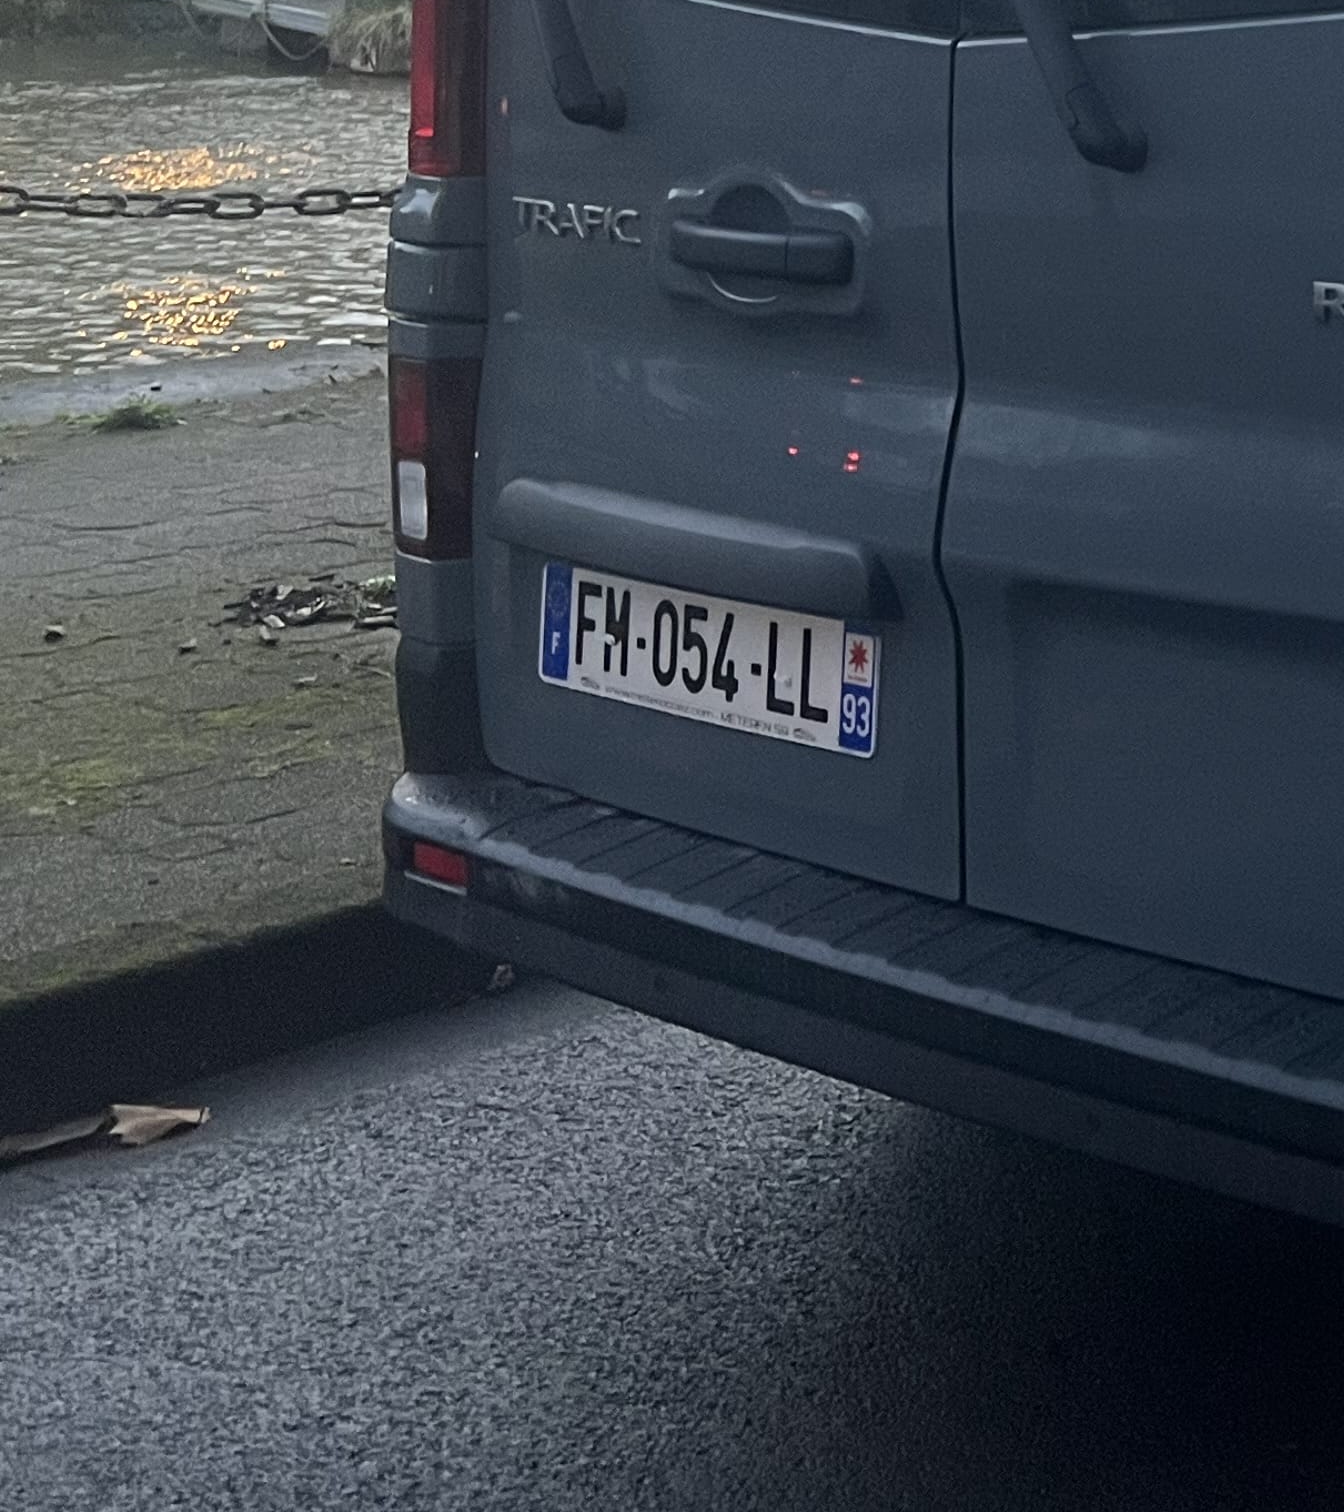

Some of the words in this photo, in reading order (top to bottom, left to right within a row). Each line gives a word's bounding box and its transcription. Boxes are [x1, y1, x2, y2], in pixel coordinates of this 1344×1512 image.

[512, 195, 642, 244] TRAFIC
[551, 631, 561, 656] F
[575, 581, 829, 724] FM-054-LL
[842, 693, 871, 738] 93
